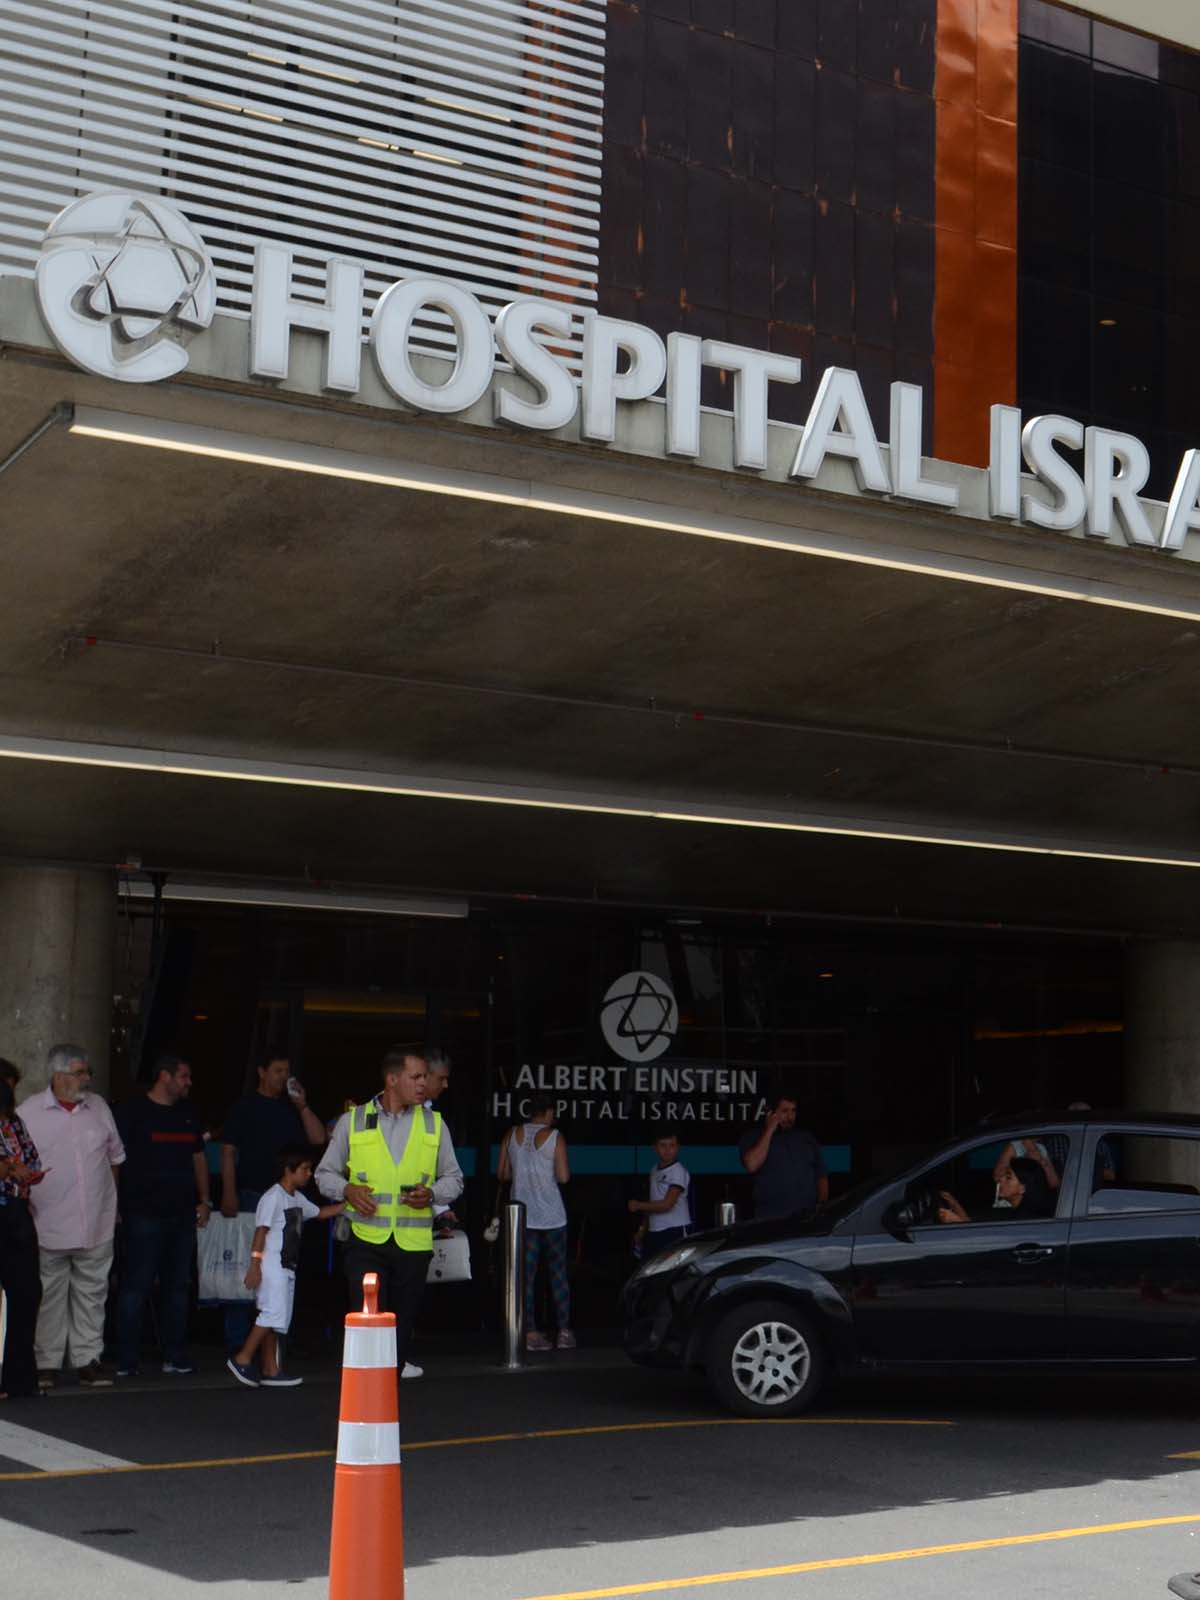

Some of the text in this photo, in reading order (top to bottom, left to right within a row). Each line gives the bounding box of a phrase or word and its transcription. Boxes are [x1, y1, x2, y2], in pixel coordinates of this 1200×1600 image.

[250, 241, 959, 508] HOSPITAL
[514, 1063, 758, 1094] ALBERT EINSTEIN
[492, 1091, 629, 1121] HOPITAL
